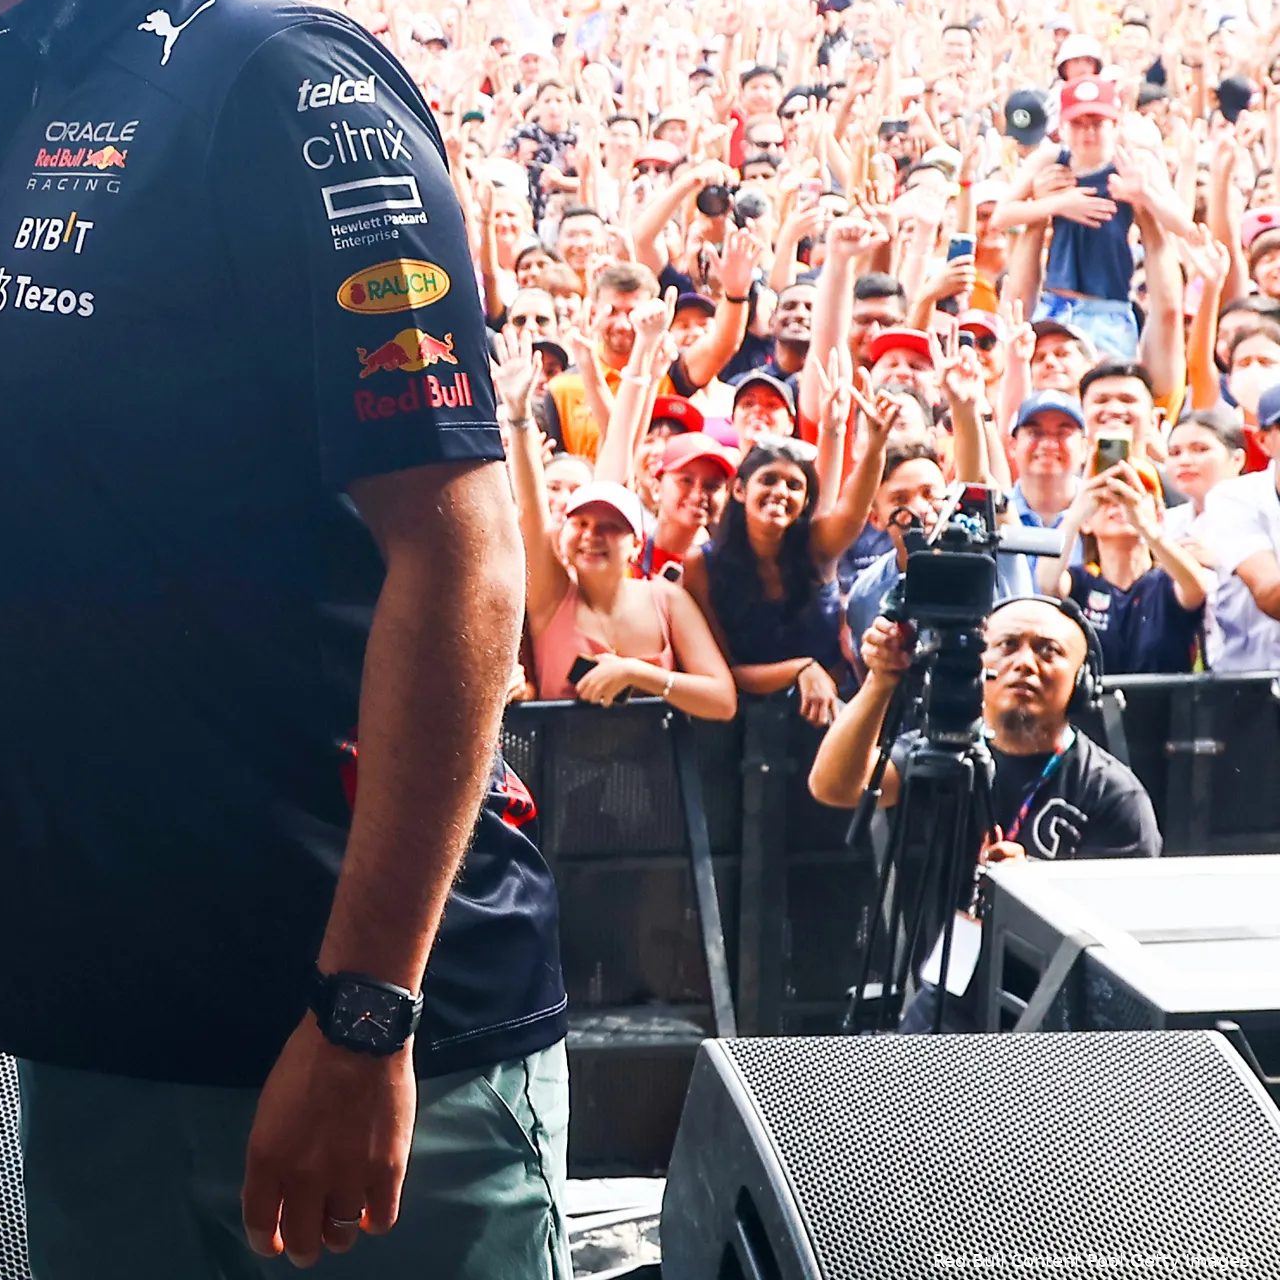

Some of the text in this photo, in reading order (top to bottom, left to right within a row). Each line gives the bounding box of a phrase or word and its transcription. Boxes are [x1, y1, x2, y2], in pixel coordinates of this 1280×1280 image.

[297, 74, 376, 112] telcel
[45, 120, 139, 142] ORACLE
[303, 119, 413, 170] citrix
[26, 178, 121, 194] RACING
[14, 212, 94, 254] BYBIT
[331, 212, 428, 237] Hewlett Packard
[334, 228, 400, 251] Enterprise
[14, 275, 95, 317] Tezos
[367, 272, 438, 301] RAUCH
[354, 372, 473, 422] Red Bull
